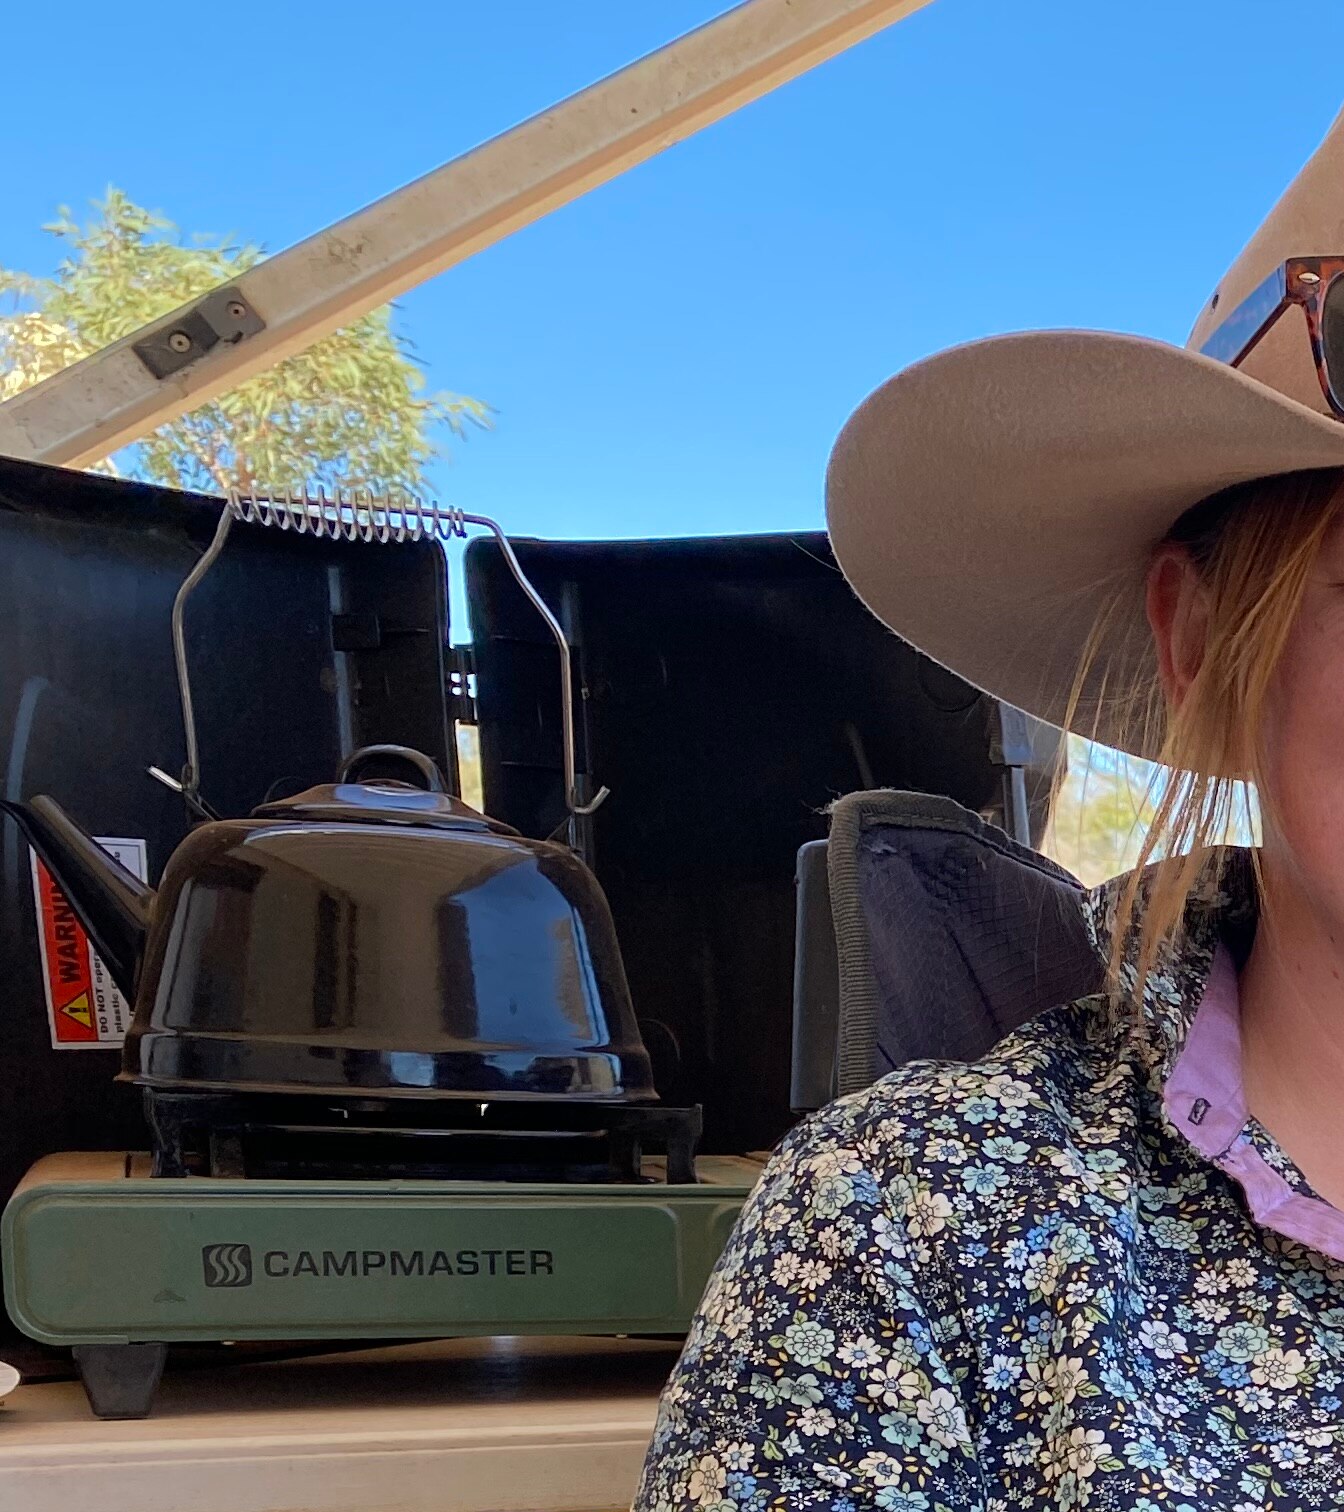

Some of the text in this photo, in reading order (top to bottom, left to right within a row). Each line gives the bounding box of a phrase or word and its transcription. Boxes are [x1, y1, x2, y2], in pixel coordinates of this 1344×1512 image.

[52, 881, 82, 985] WARNI
[95, 986, 106, 1014] NOT
[263, 1249, 555, 1278] CAMPMASTER
